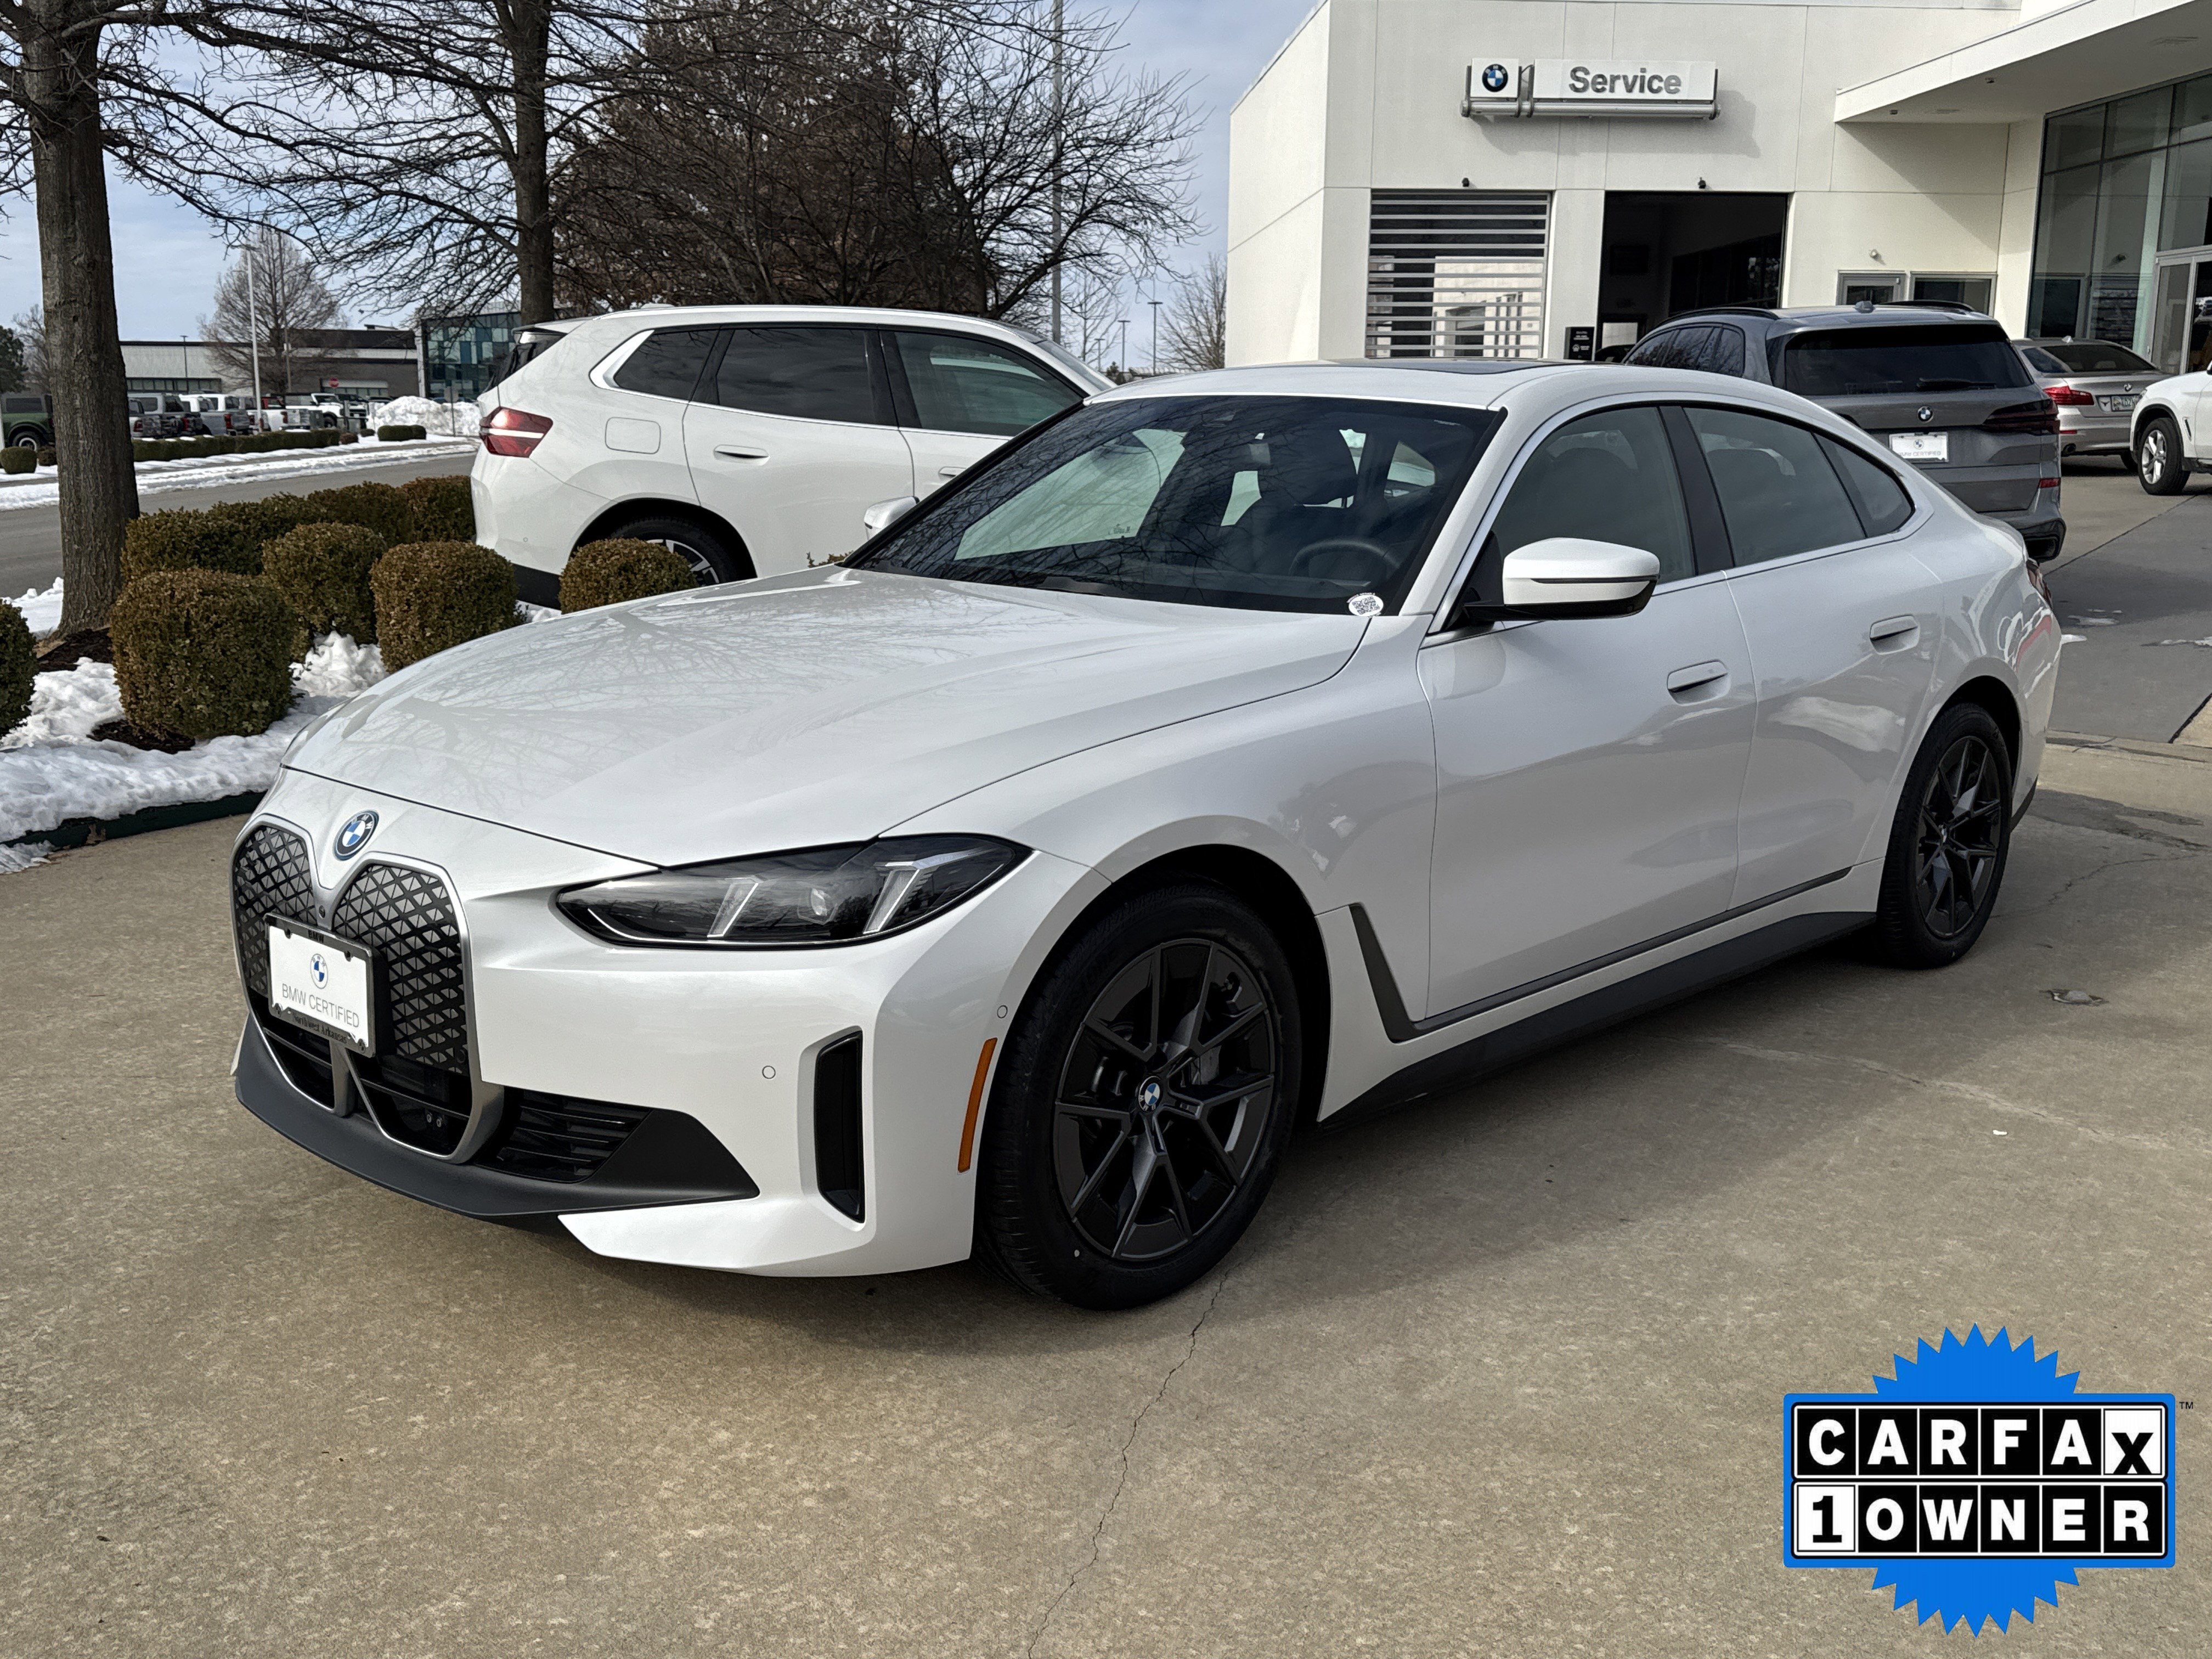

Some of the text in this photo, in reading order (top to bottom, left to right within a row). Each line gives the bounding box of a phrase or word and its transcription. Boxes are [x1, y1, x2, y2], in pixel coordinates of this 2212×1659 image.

[1568, 66, 1681, 94] Service
[351, 814, 373, 829] BMW
[308, 930, 324, 943] BMW
[282, 983, 359, 1027] BMW CERTIFIED
[292, 1012, 346, 1044] Northwest Arkansas
